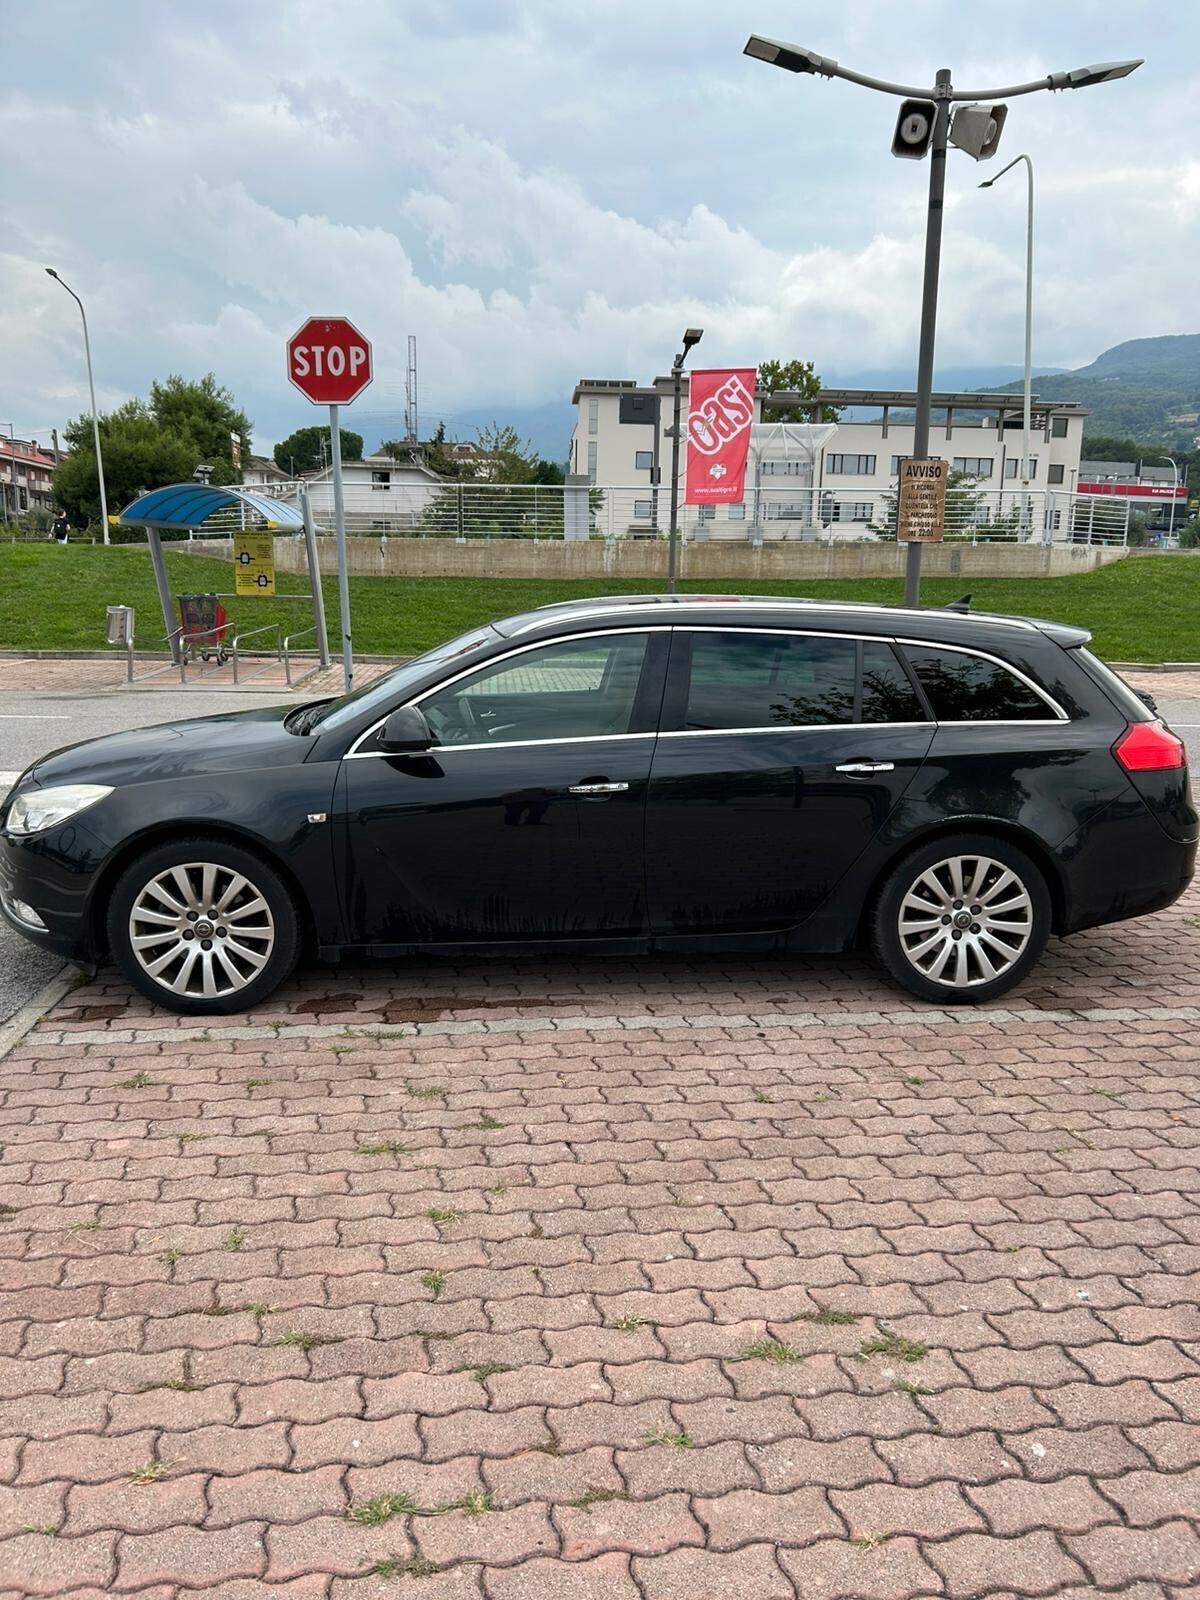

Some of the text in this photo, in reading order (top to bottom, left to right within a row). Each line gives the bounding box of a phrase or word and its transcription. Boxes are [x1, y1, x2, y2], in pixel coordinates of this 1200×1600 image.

[294, 345, 366, 377] STOP
[688, 374, 754, 456] Oasi
[906, 465, 942, 478] AVVISO
[918, 528, 934, 537] 22:00
